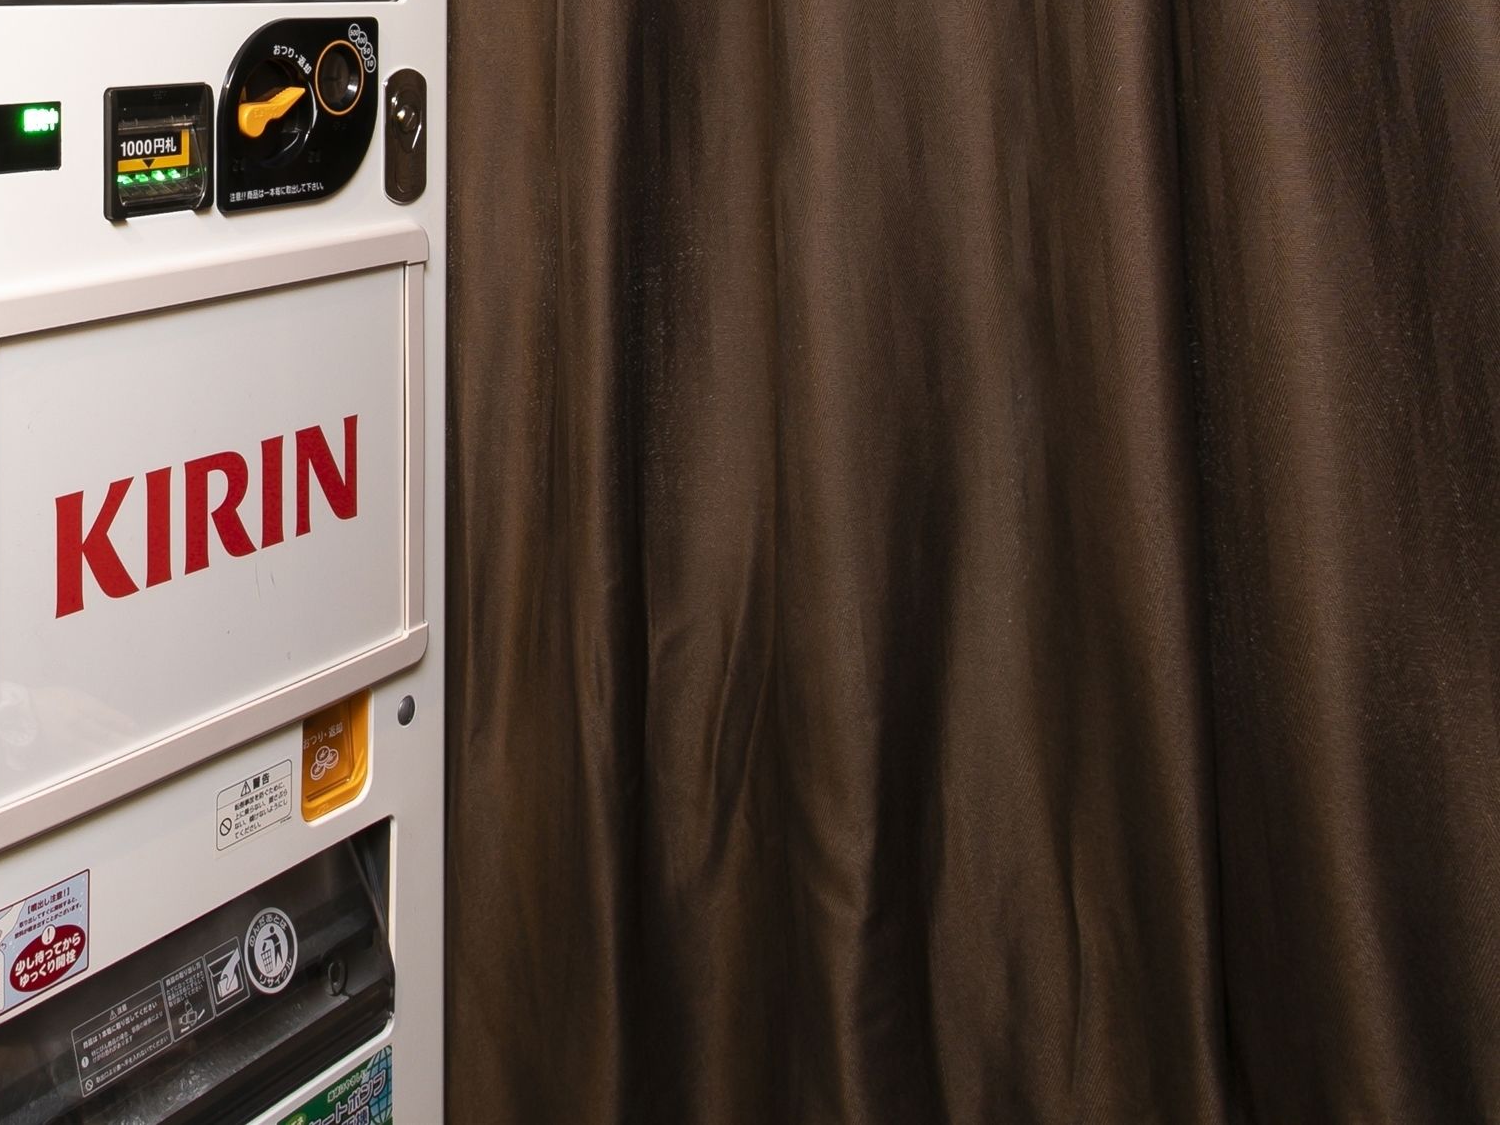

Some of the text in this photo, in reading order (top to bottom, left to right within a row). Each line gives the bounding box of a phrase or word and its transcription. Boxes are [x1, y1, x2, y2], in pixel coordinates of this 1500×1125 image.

[363, 47, 371, 55] 50
[367, 58, 374, 67] 10
[120, 136, 177, 156] 1000円札
[55, 414, 358, 619] KIRIN
[249, 914, 287, 947] のんだあとは
[15, 932, 81, 976] 少し待ってから
[19, 949, 77, 988] ゆっくり開栓
[259, 958, 293, 987] リサイクル
